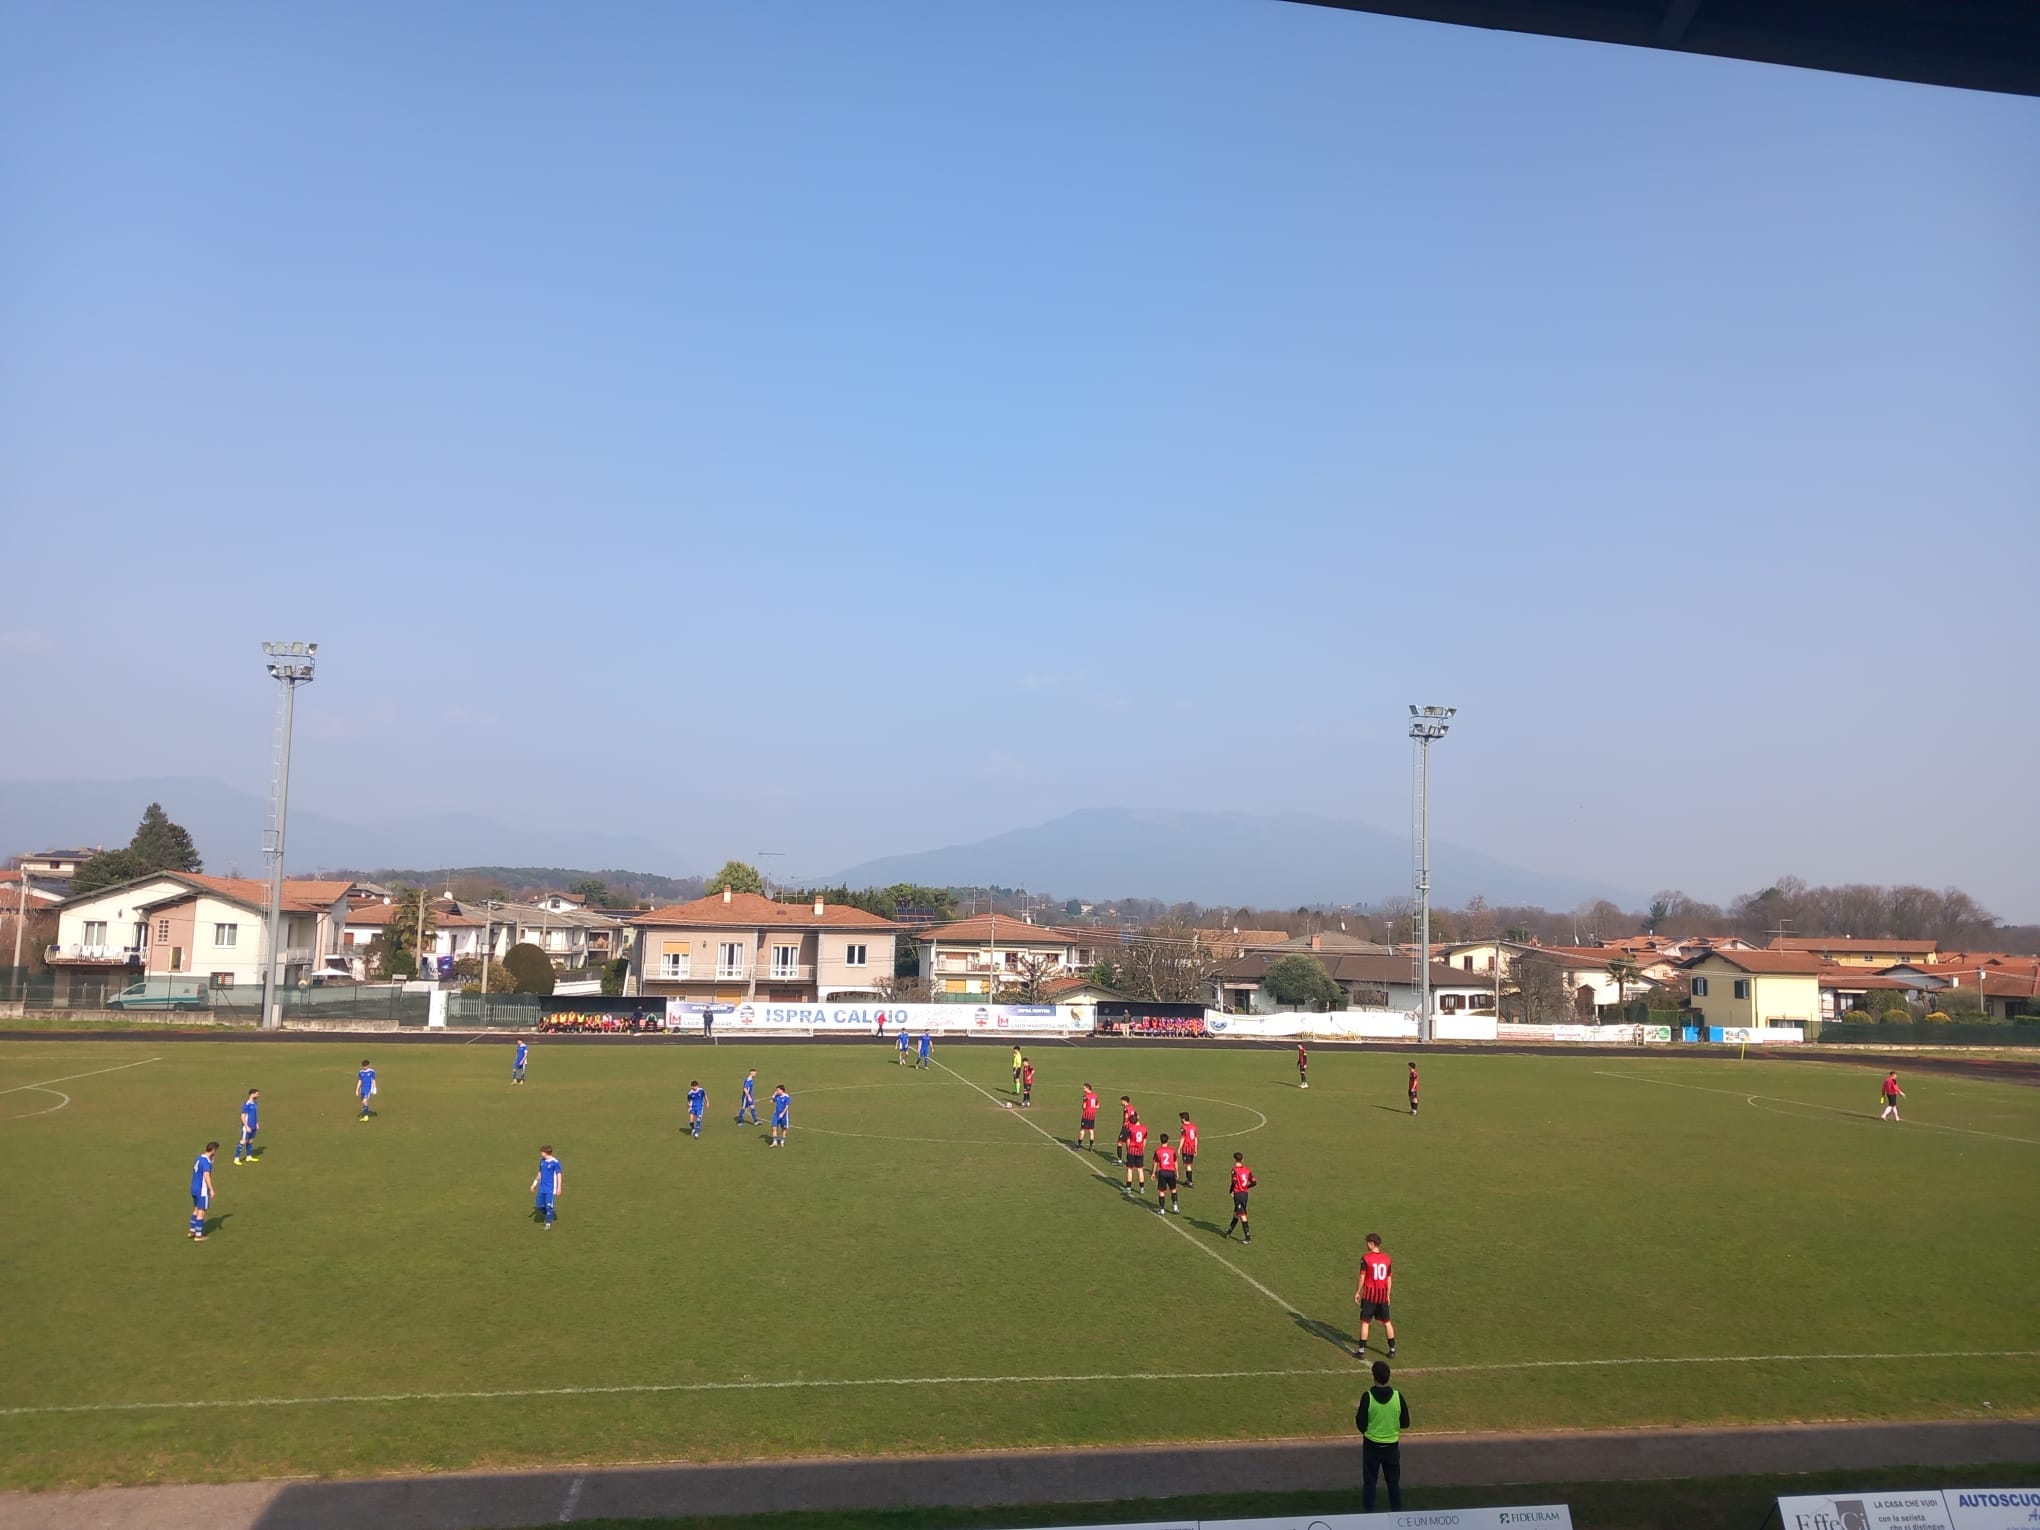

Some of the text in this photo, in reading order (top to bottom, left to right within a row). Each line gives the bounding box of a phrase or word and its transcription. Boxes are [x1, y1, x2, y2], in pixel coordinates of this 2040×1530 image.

[766, 1009, 826, 1023] ISPRA
[834, 1009, 909, 1024] CALCIO
[1135, 1131, 1143, 1143] 9
[1162, 1152, 1170, 1165] 2
[193, 1159, 199, 1174] 4
[1372, 1263, 1387, 1281] 10
[1873, 1500, 1883, 1509] LA
[1884, 1500, 1904, 1508] CASA
[1904, 1500, 1920, 1508] CHE
[1959, 1493, 2040, 1507] AUTOSCUO
[1413, 1516, 1427, 1527] UN
[1429, 1515, 1460, 1526] MODO
[1511, 1512, 1560, 1522] FIDEURAM
